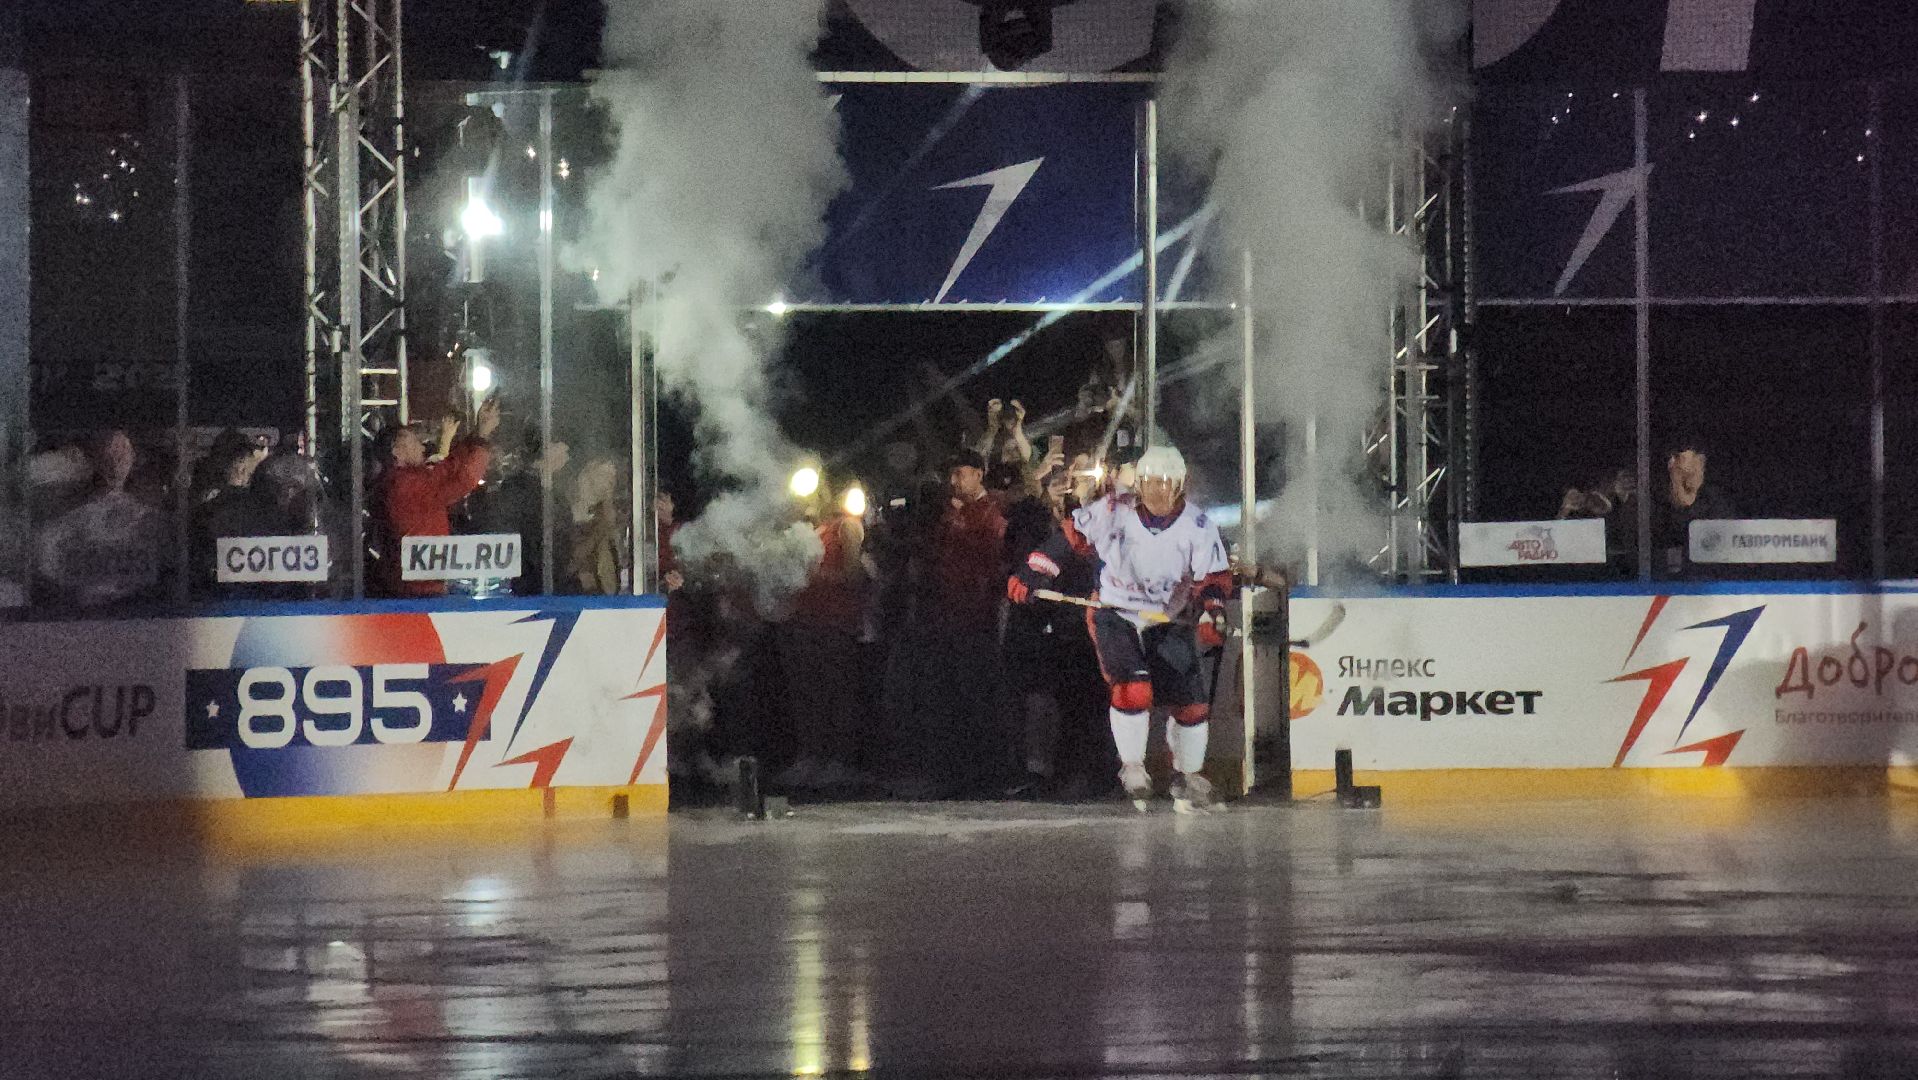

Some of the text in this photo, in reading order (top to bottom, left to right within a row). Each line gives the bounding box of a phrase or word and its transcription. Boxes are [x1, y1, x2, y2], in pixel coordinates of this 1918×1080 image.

[1732, 534, 1828, 548] ГАЗПРОМБАНК
[226, 544, 319, 573] согаз
[409, 542, 514, 571] KHL.RU
[1338, 655, 1436, 681] Яндекс
[238, 663, 432, 748] 895
[1337, 685, 1543, 721] Маркет
